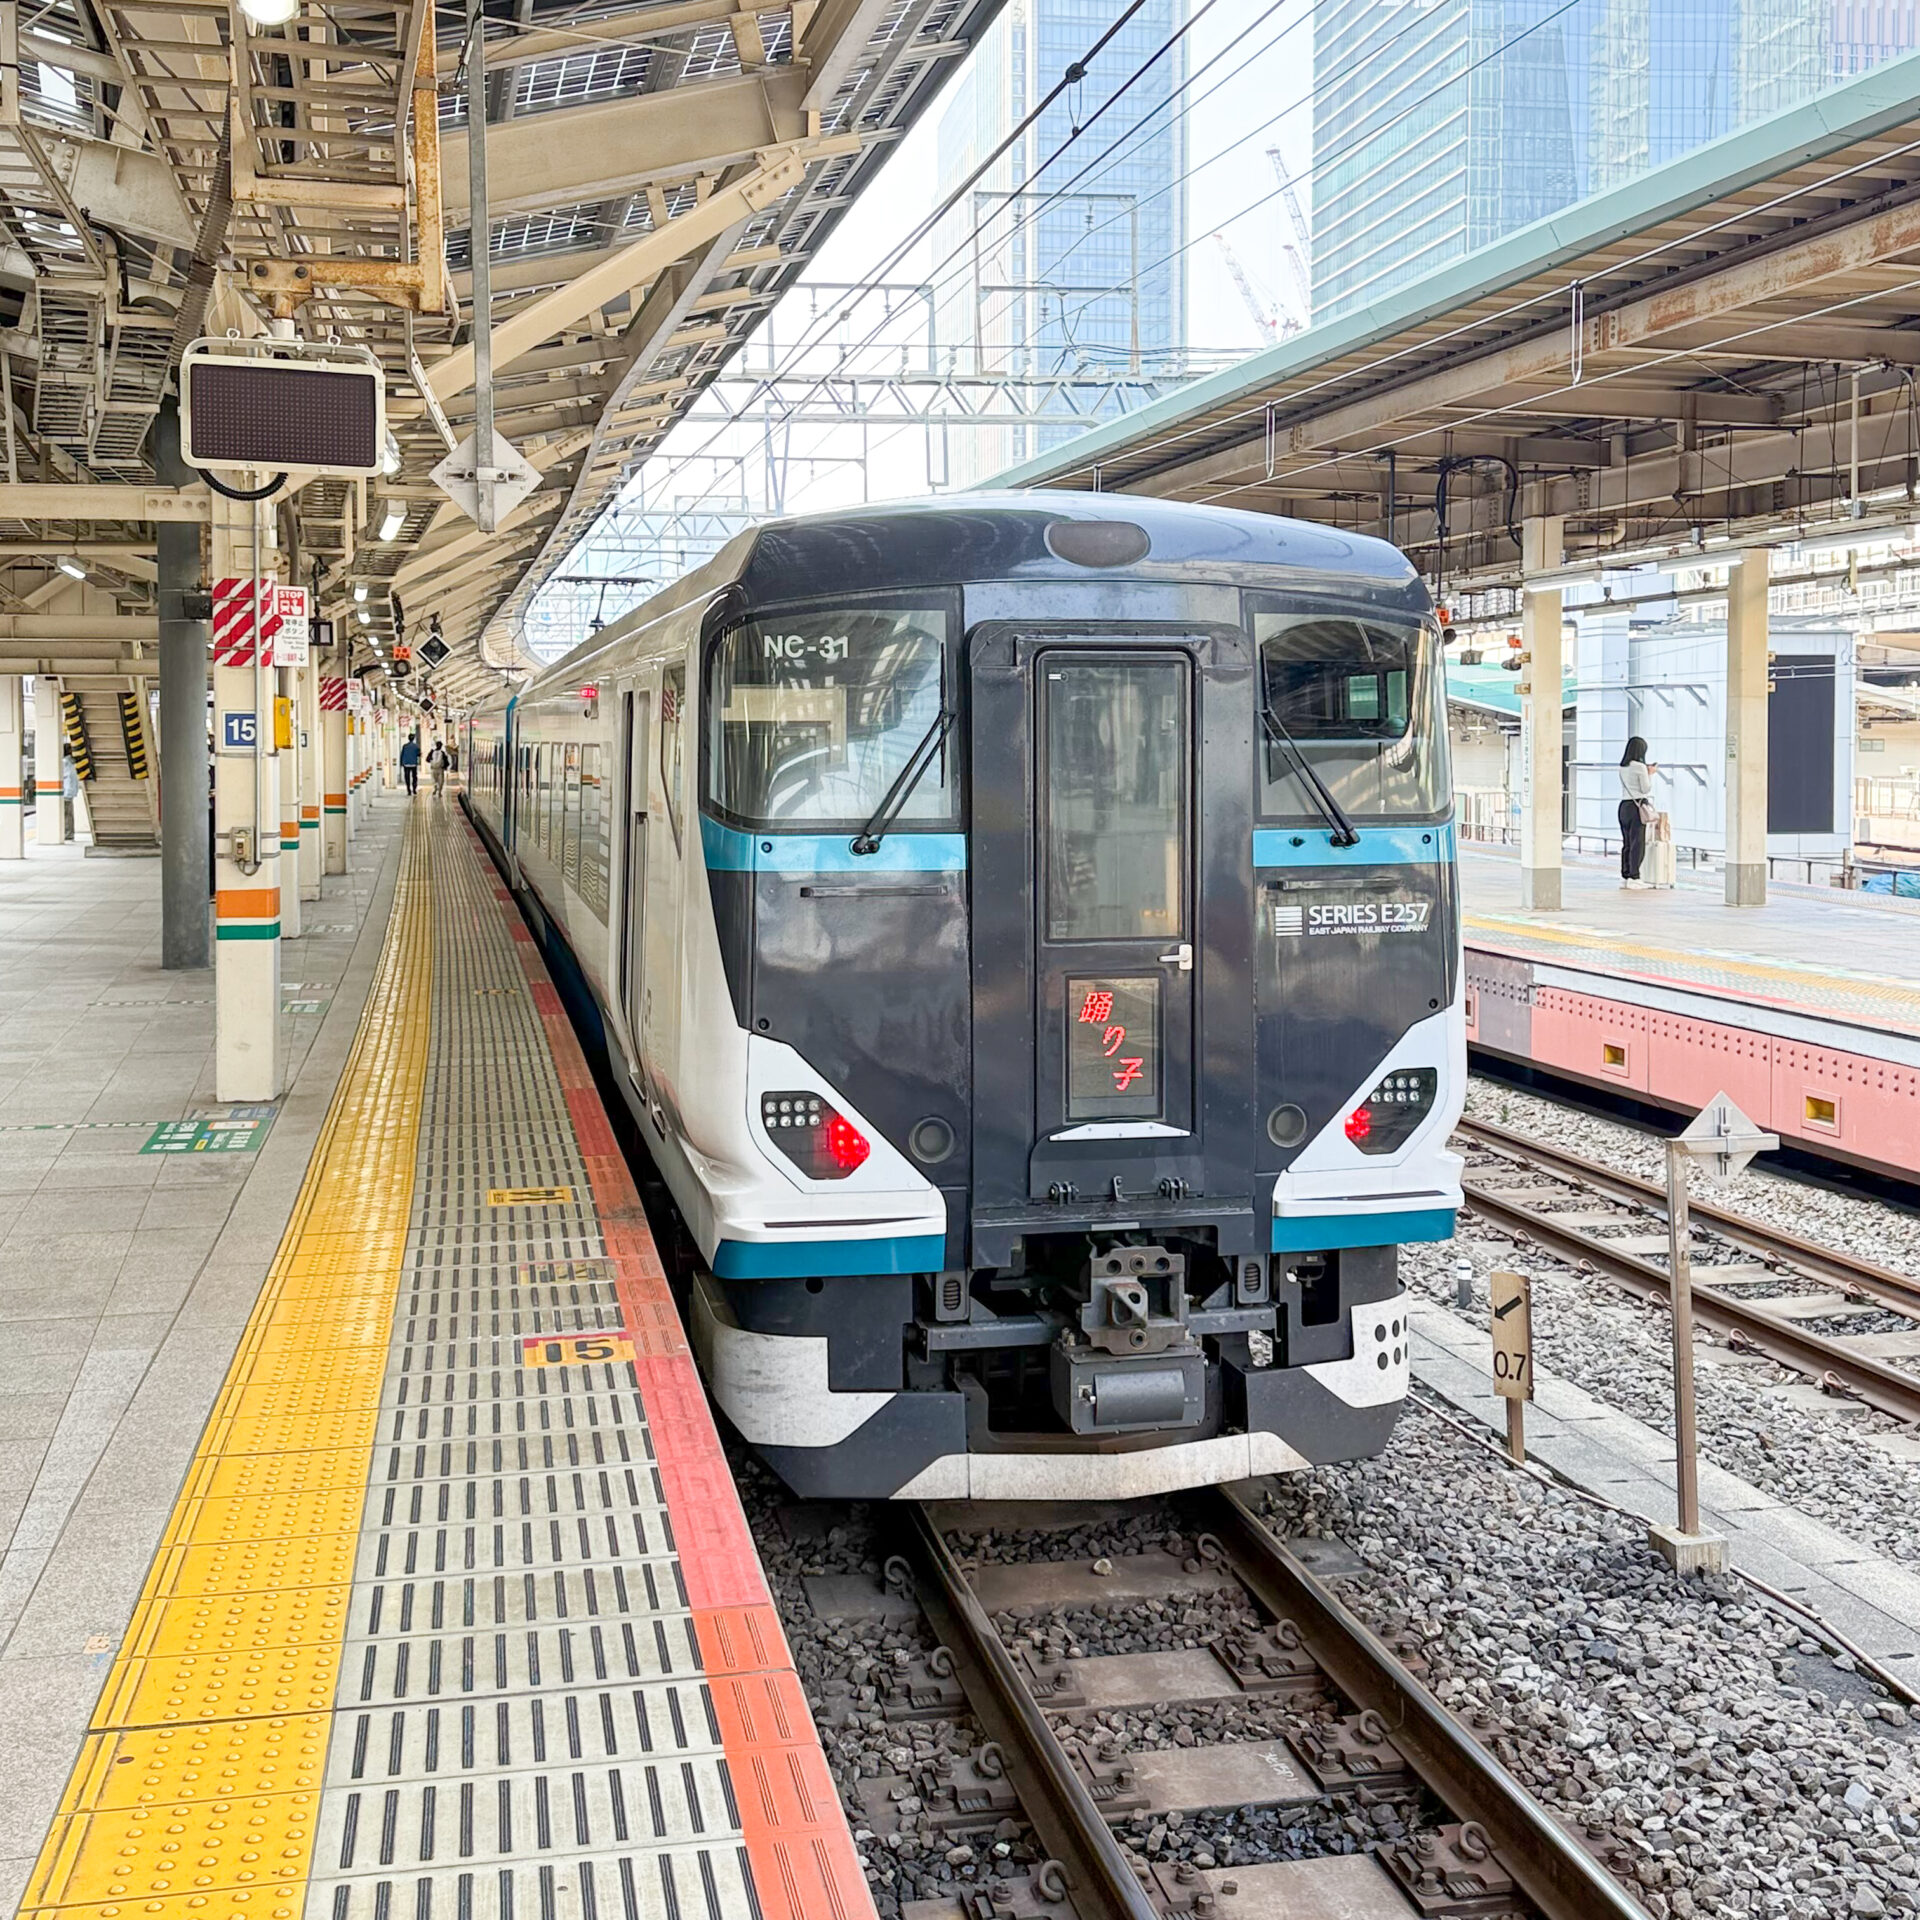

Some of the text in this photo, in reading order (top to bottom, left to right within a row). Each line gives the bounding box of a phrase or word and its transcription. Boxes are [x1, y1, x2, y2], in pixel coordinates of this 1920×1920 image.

[279, 591, 303, 599] STOP
[763, 635, 849, 658] NC-31
[228, 719, 256, 741] 15
[1309, 903, 1428, 925] SERIES E257
[1309, 924, 1429, 935] EAST JAPAN RAILWAY COMPANY
[1078, 992, 1144, 1091] 踊り子
[1494, 1351, 1526, 1381] 0.7
